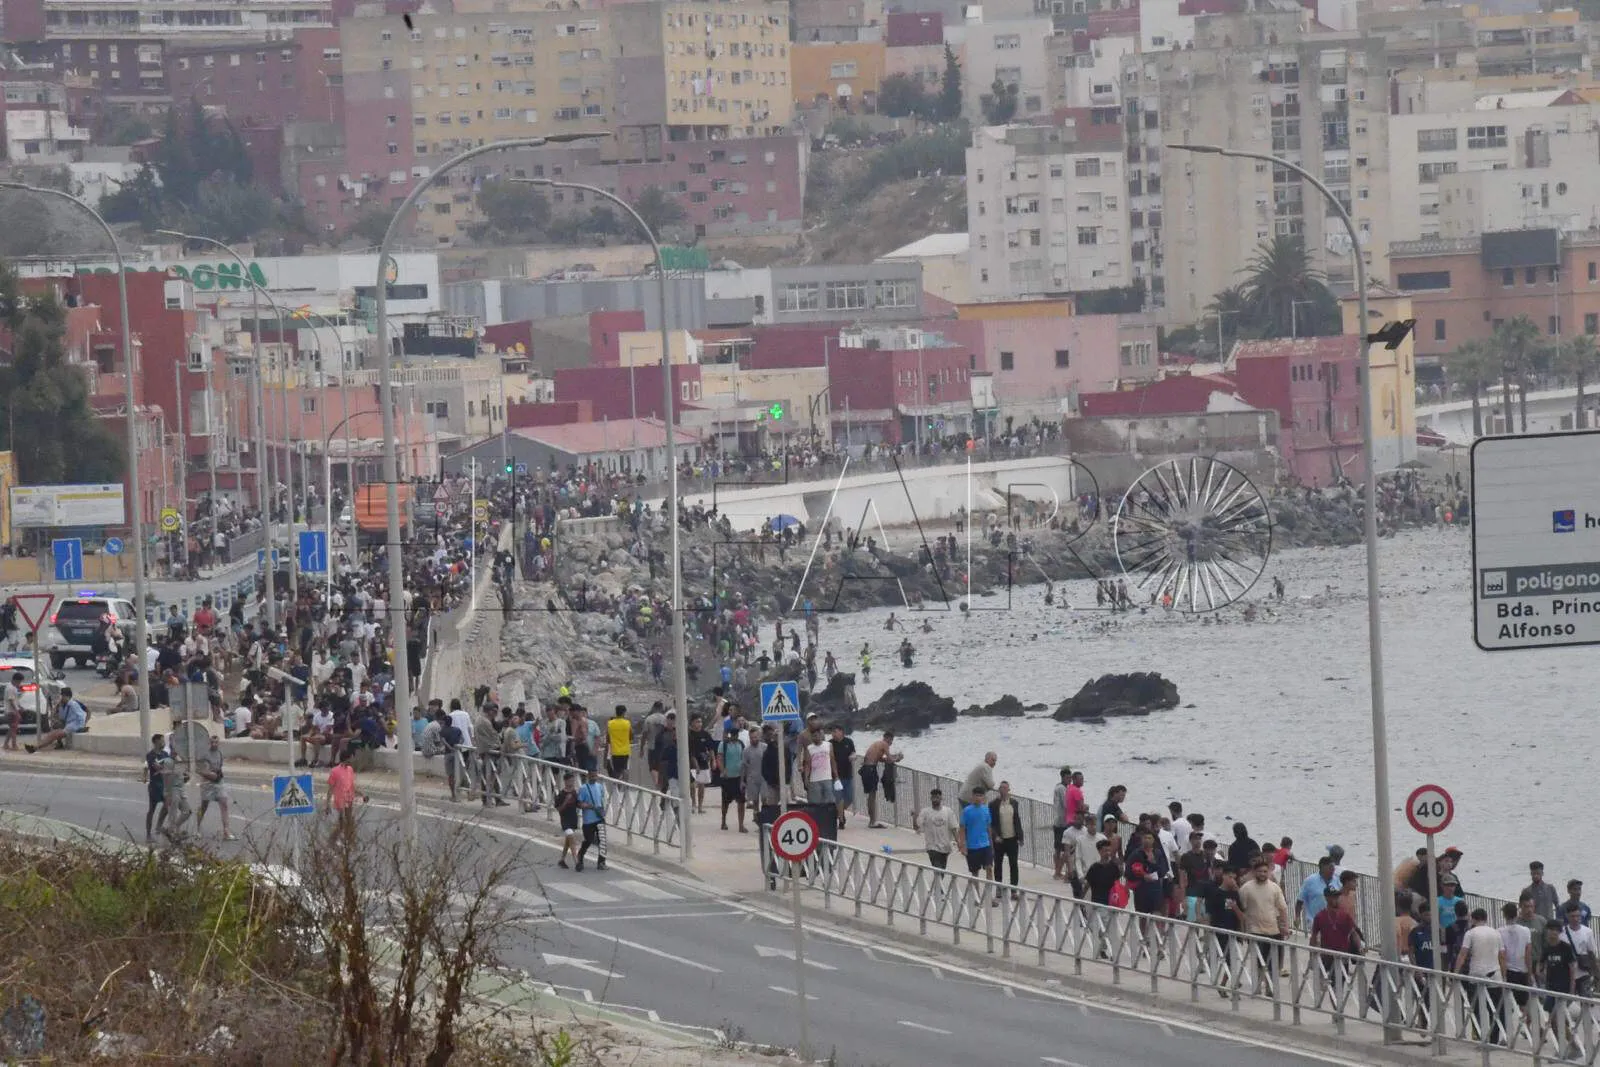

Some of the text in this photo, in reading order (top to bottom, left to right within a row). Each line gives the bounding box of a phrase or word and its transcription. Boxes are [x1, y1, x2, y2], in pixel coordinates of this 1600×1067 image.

[1585, 512, 1600, 529] h
[1497, 601, 1539, 618] Bda.
[1498, 622, 1576, 640] Alfonso
[1416, 801, 1444, 818] 40
[781, 828, 809, 845] 40
